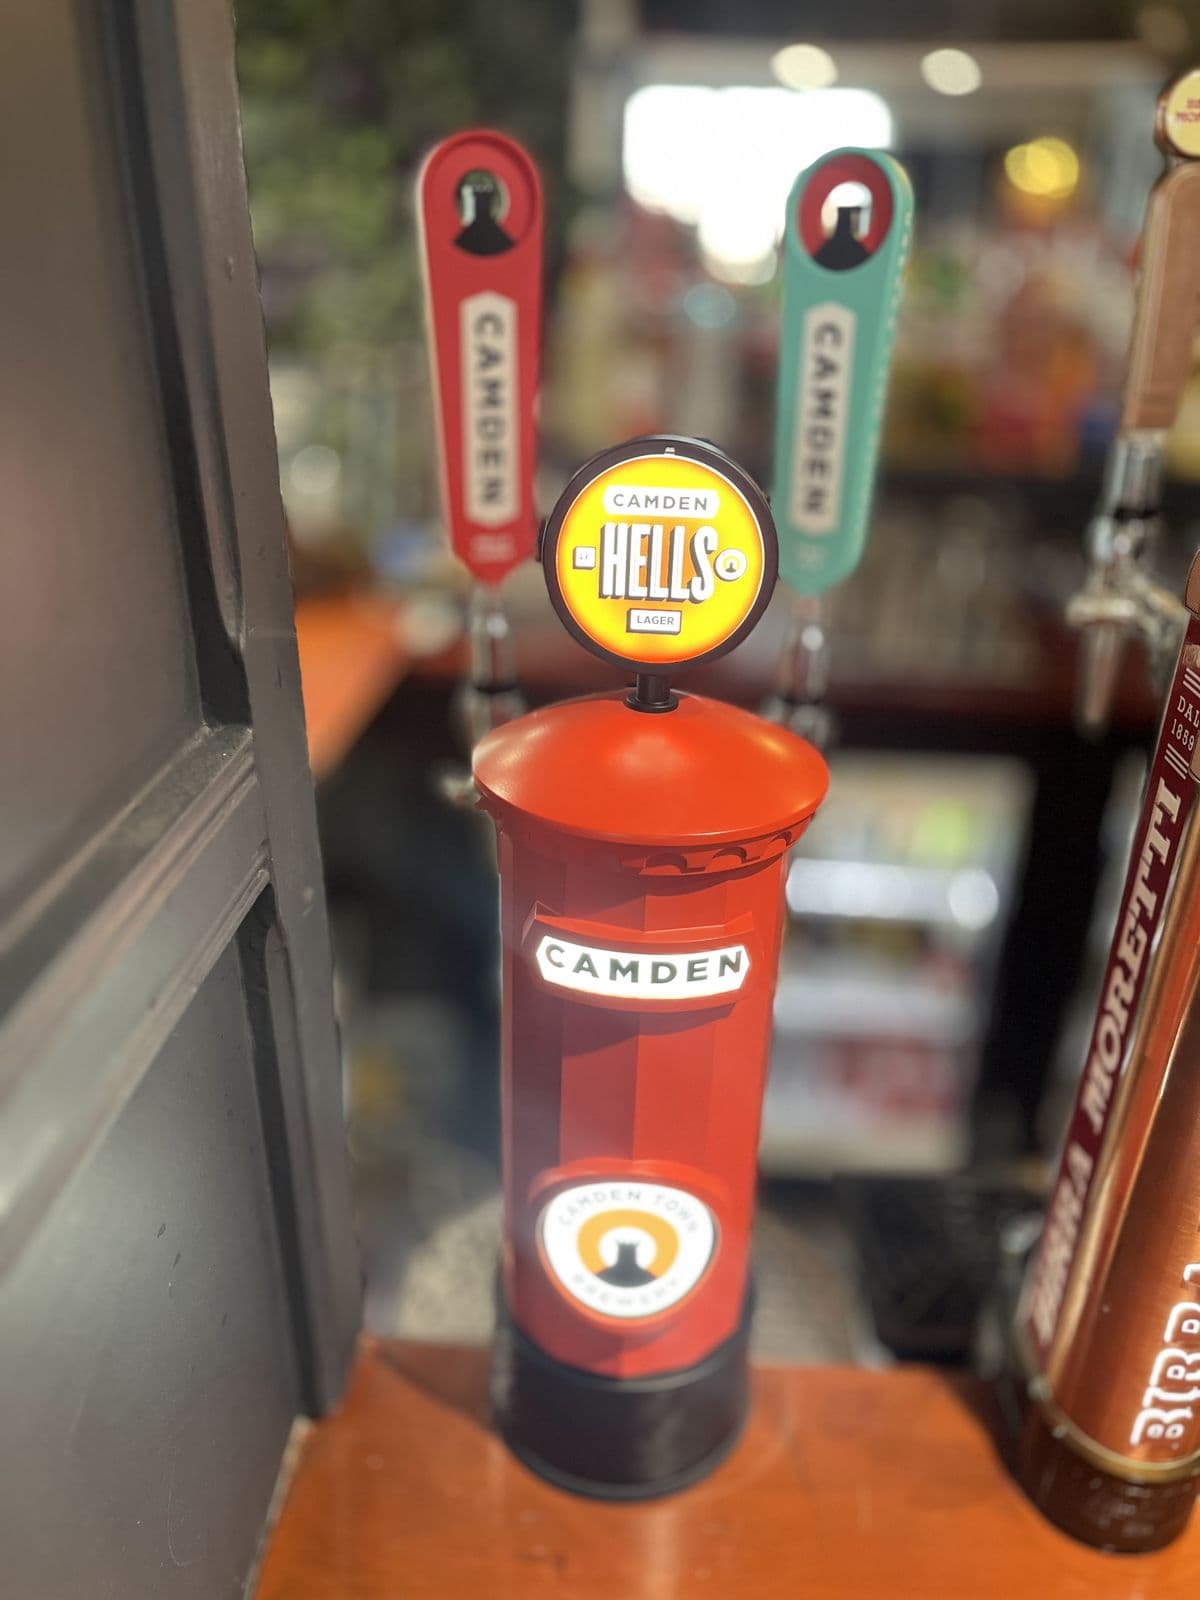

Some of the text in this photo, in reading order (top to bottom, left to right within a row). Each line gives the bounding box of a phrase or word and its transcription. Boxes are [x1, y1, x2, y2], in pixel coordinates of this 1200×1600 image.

[472, 312, 506, 505] CAMDEN
[806, 322, 843, 514] CAMDEN
[612, 493, 709, 511] CAMDEN
[598, 521, 719, 605] HELLS
[635, 614, 675, 626] LAGER
[1177, 695, 1200, 728] DAL
[1171, 718, 1195, 752] 1859
[545, 943, 743, 985] CAMDEN
[1080, 776, 1182, 1136] MORETTI
